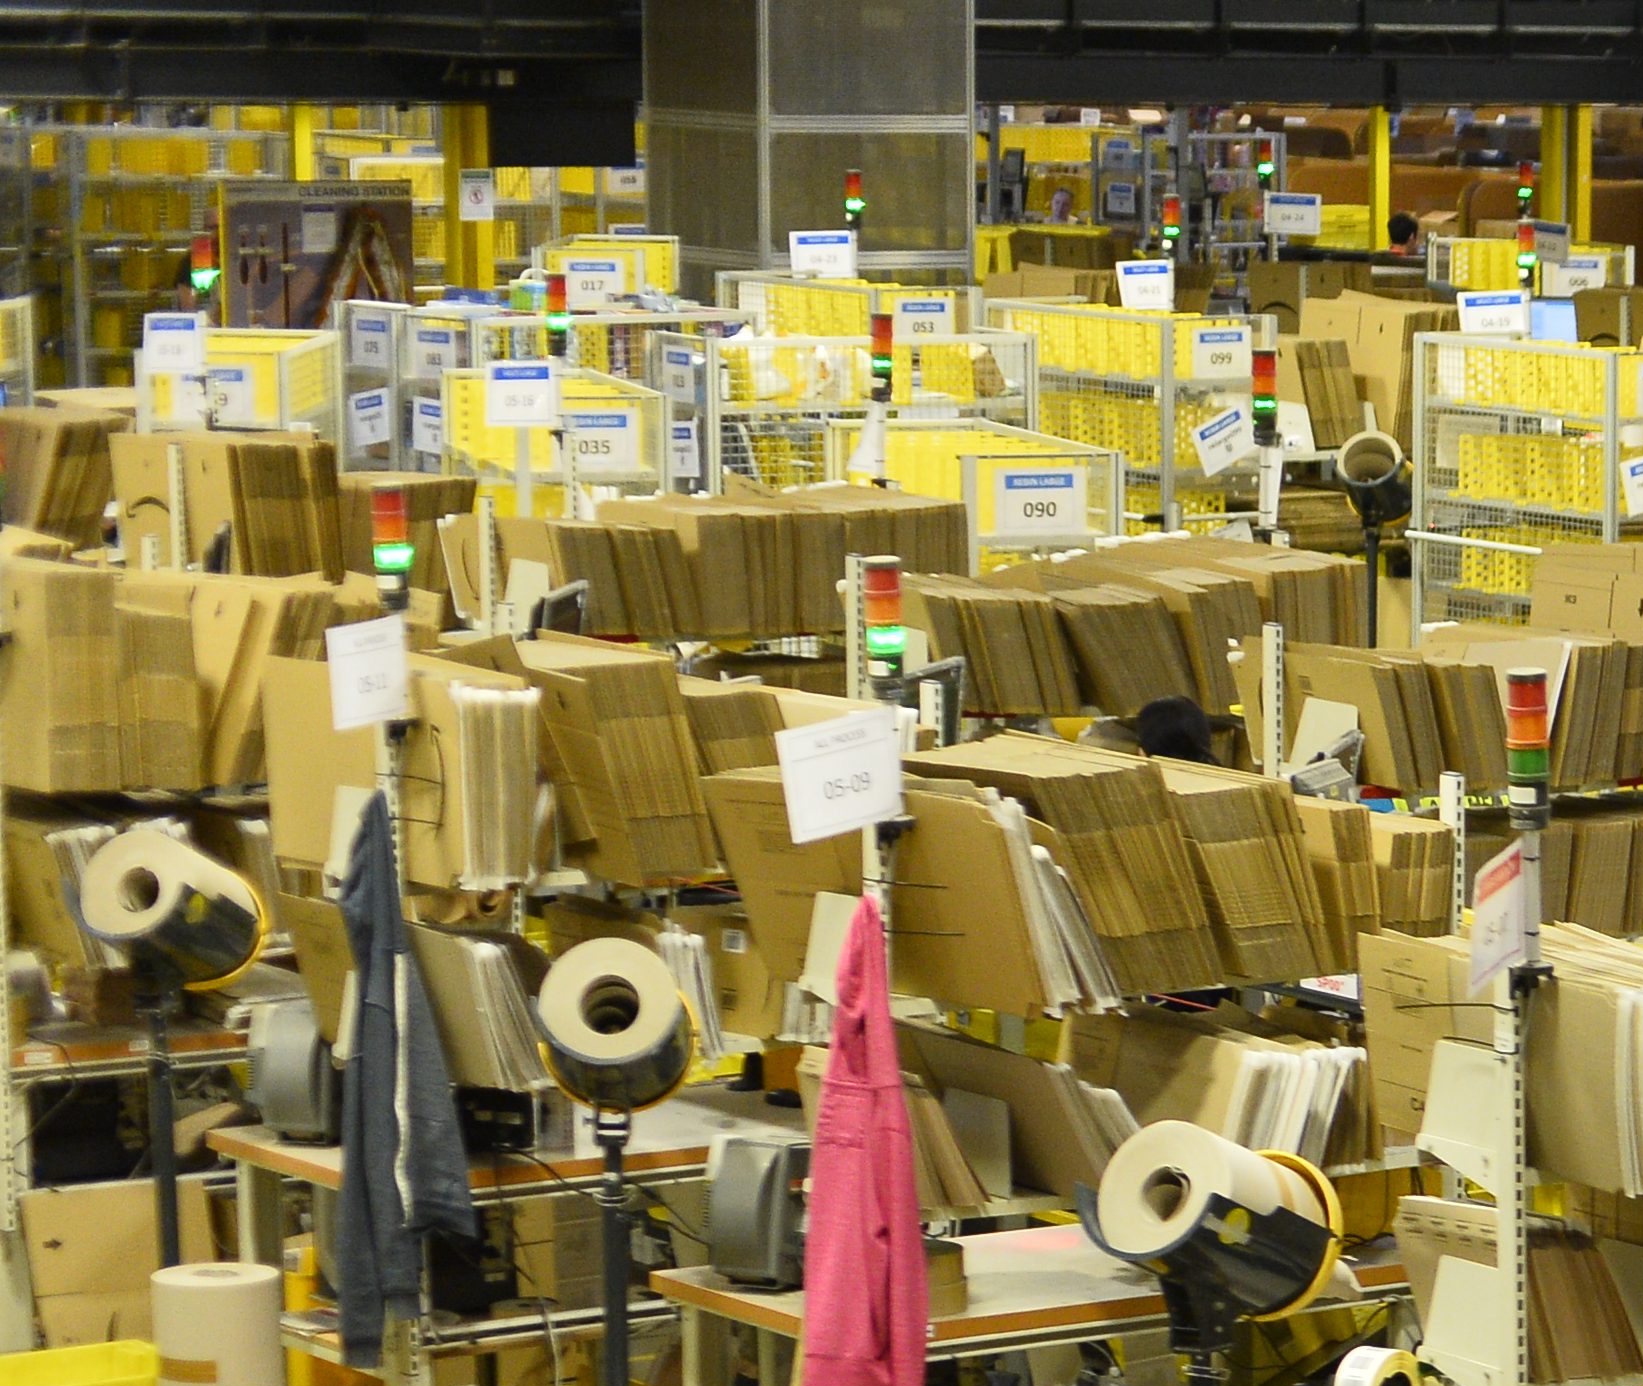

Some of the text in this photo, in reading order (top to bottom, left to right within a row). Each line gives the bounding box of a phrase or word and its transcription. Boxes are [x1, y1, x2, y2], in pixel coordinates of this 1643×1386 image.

[299, 187, 359, 197] CLEANING
[580, 281, 604, 291] 017
[912, 321, 934, 333] 053
[1210, 352, 1232, 365] 099
[579, 440, 610, 454] 035
[1023, 501, 1057, 518] 090
[822, 771, 871, 801] 05-09
